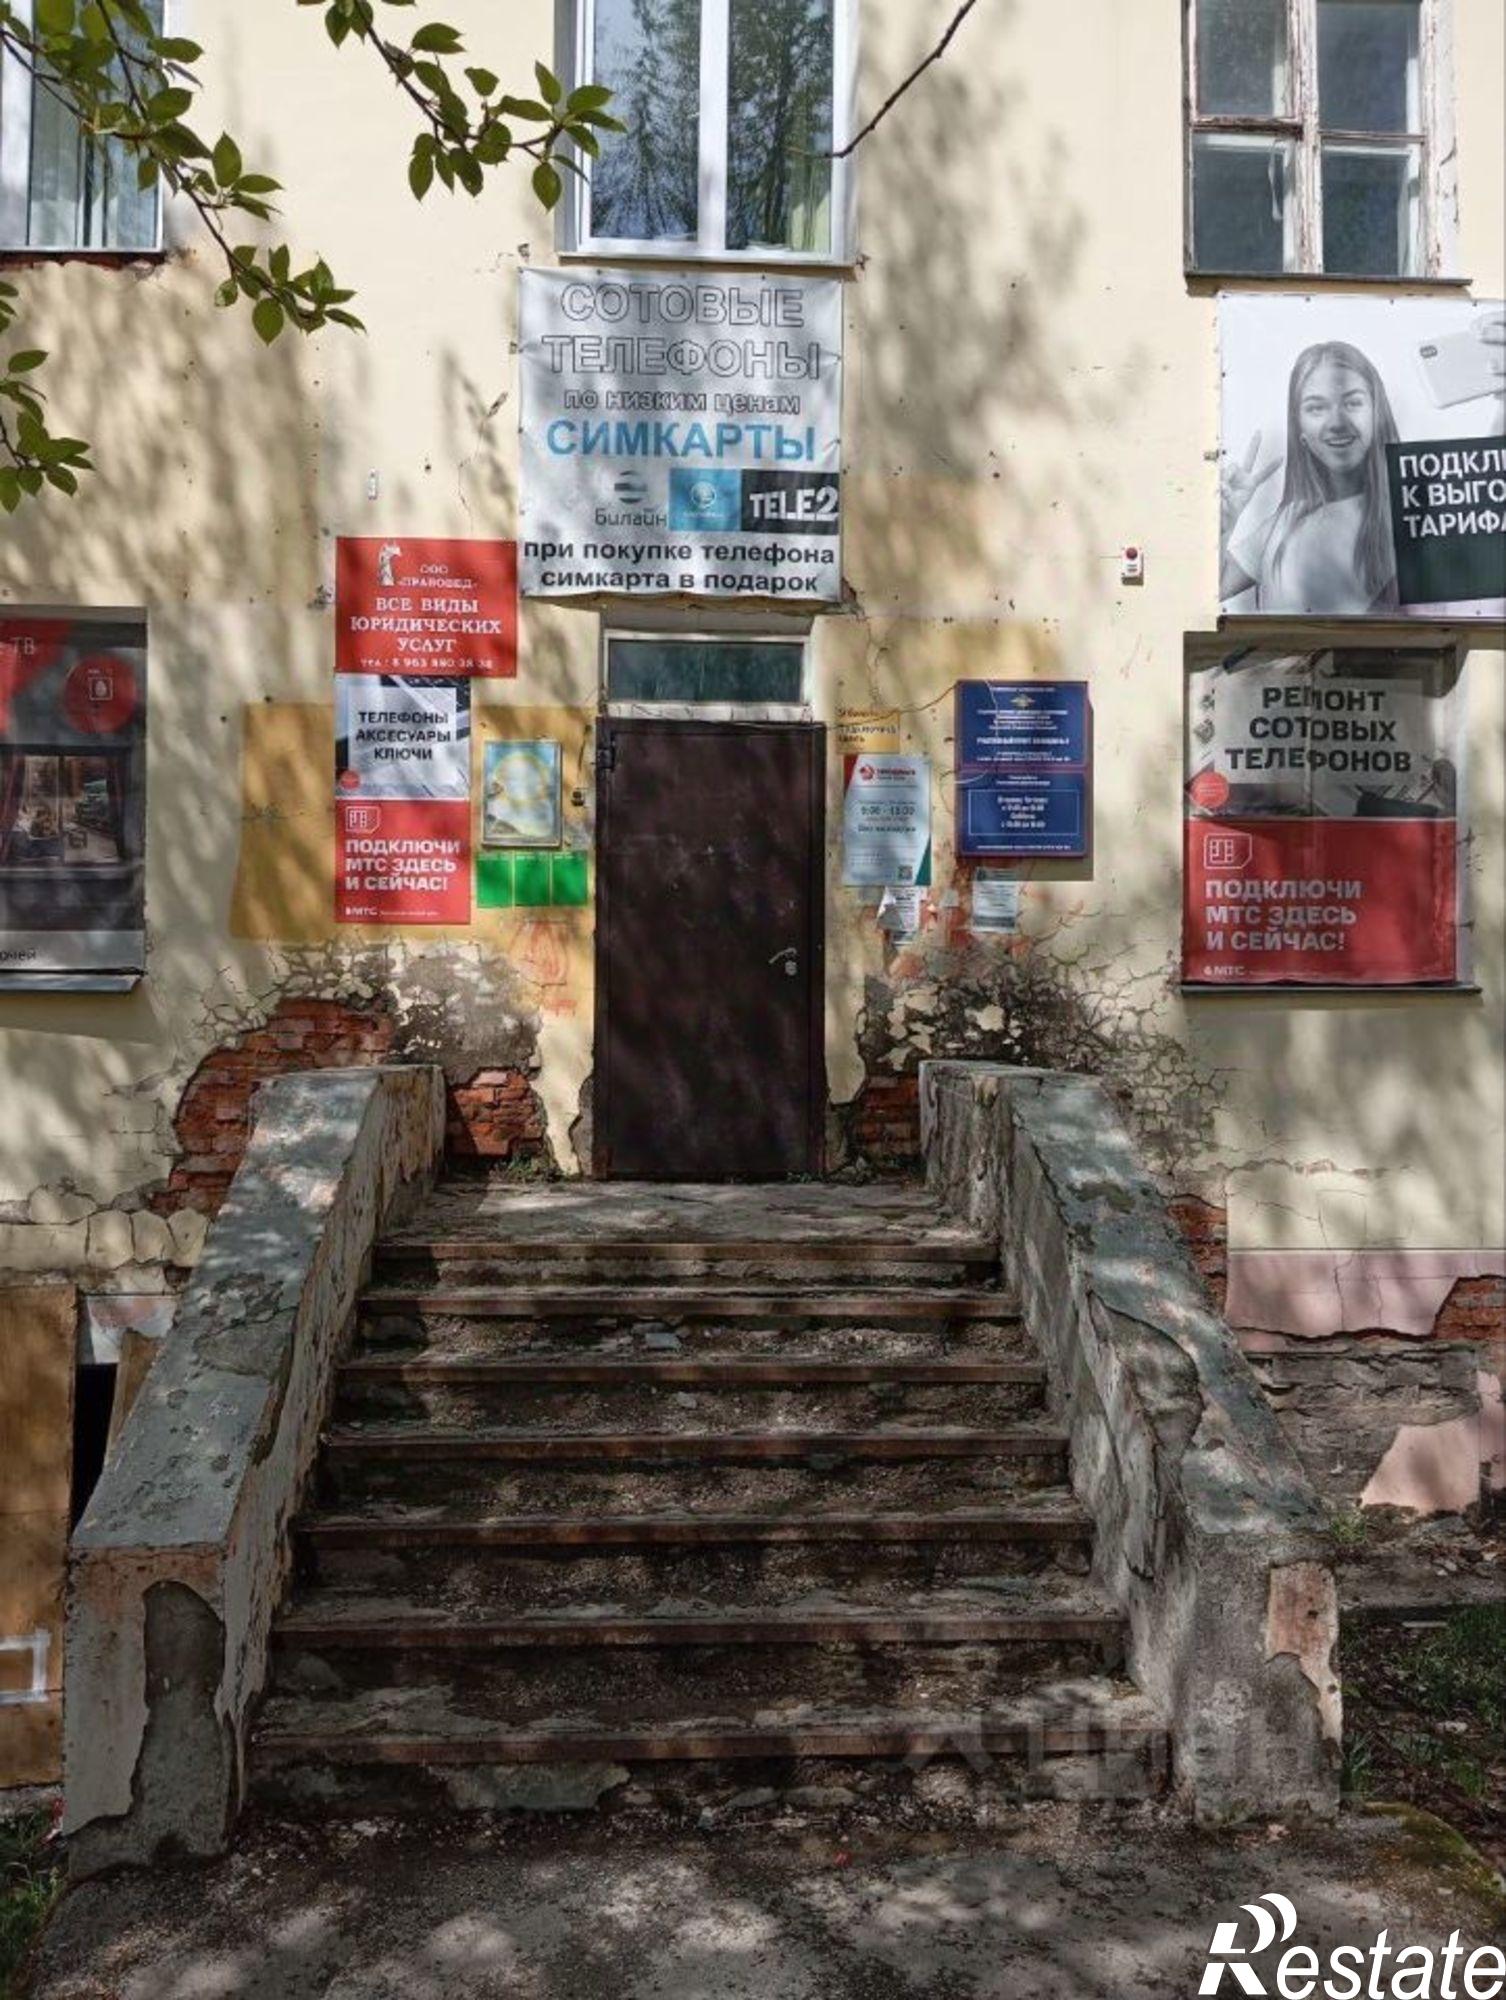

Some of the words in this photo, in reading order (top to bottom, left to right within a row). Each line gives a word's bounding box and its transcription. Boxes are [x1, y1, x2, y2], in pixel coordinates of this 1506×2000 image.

[561, 283, 805, 327] СОТОВЫЕ
[541, 335, 820, 380] ТЕЛЕФОНЫ
[564, 389, 598, 409] по
[605, 390, 707, 412] низким
[714, 393, 801, 415] ценам
[546, 419, 815, 461] СИМКАРТЫ
[1399, 448, 1506, 480] ПОДКЛ
[749, 485, 839, 522] TELE2
[1401, 485, 1420, 508] К
[595, 508, 667, 526] Билайн
[1403, 510, 1506, 538] ТАРИФ
[523, 541, 574, 563] при
[583, 542, 692, 564] покупке
[700, 543, 835, 566] телефона
[541, 570, 670, 591] симкарта
[679, 573, 695, 588] в
[704, 573, 818, 593] подарок
[376, 598, 412, 611] ВСЕ
[422, 598, 478, 613] ВИДЫ
[350, 617, 502, 634] ЮРИДИЧЕСКИХ
[397, 638, 457, 652] УСЛУГ
[358, 711, 448, 725] ТЕЛЕФОНЫ
[1249, 716, 1397, 743] СОТОВЫХ
[355, 729, 451, 743] АКСЕСУАРЫ
[374, 747, 433, 761] КЛЮЧИ
[1224, 748, 1412, 772] ТЕЛЕФОНОВ
[345, 839, 460, 857] ПОДКЛЮЧИ
[345, 858, 387, 872] МТС
[392, 858, 457, 876] ЗДЕСЬ
[345, 876, 359, 891] И
[364, 872, 448, 891] СЕЙЧАС!
[1205, 879, 1363, 903] ПОДКЛЮЧИ
[1205, 906, 1262, 925] МТС
[1269, 905, 1357, 929] ЗДЕСЬ
[1206, 931, 1224, 950] И
[1231, 924, 1345, 951] СЕЙЧАС!
[1214, 966, 1245, 976] МТС
